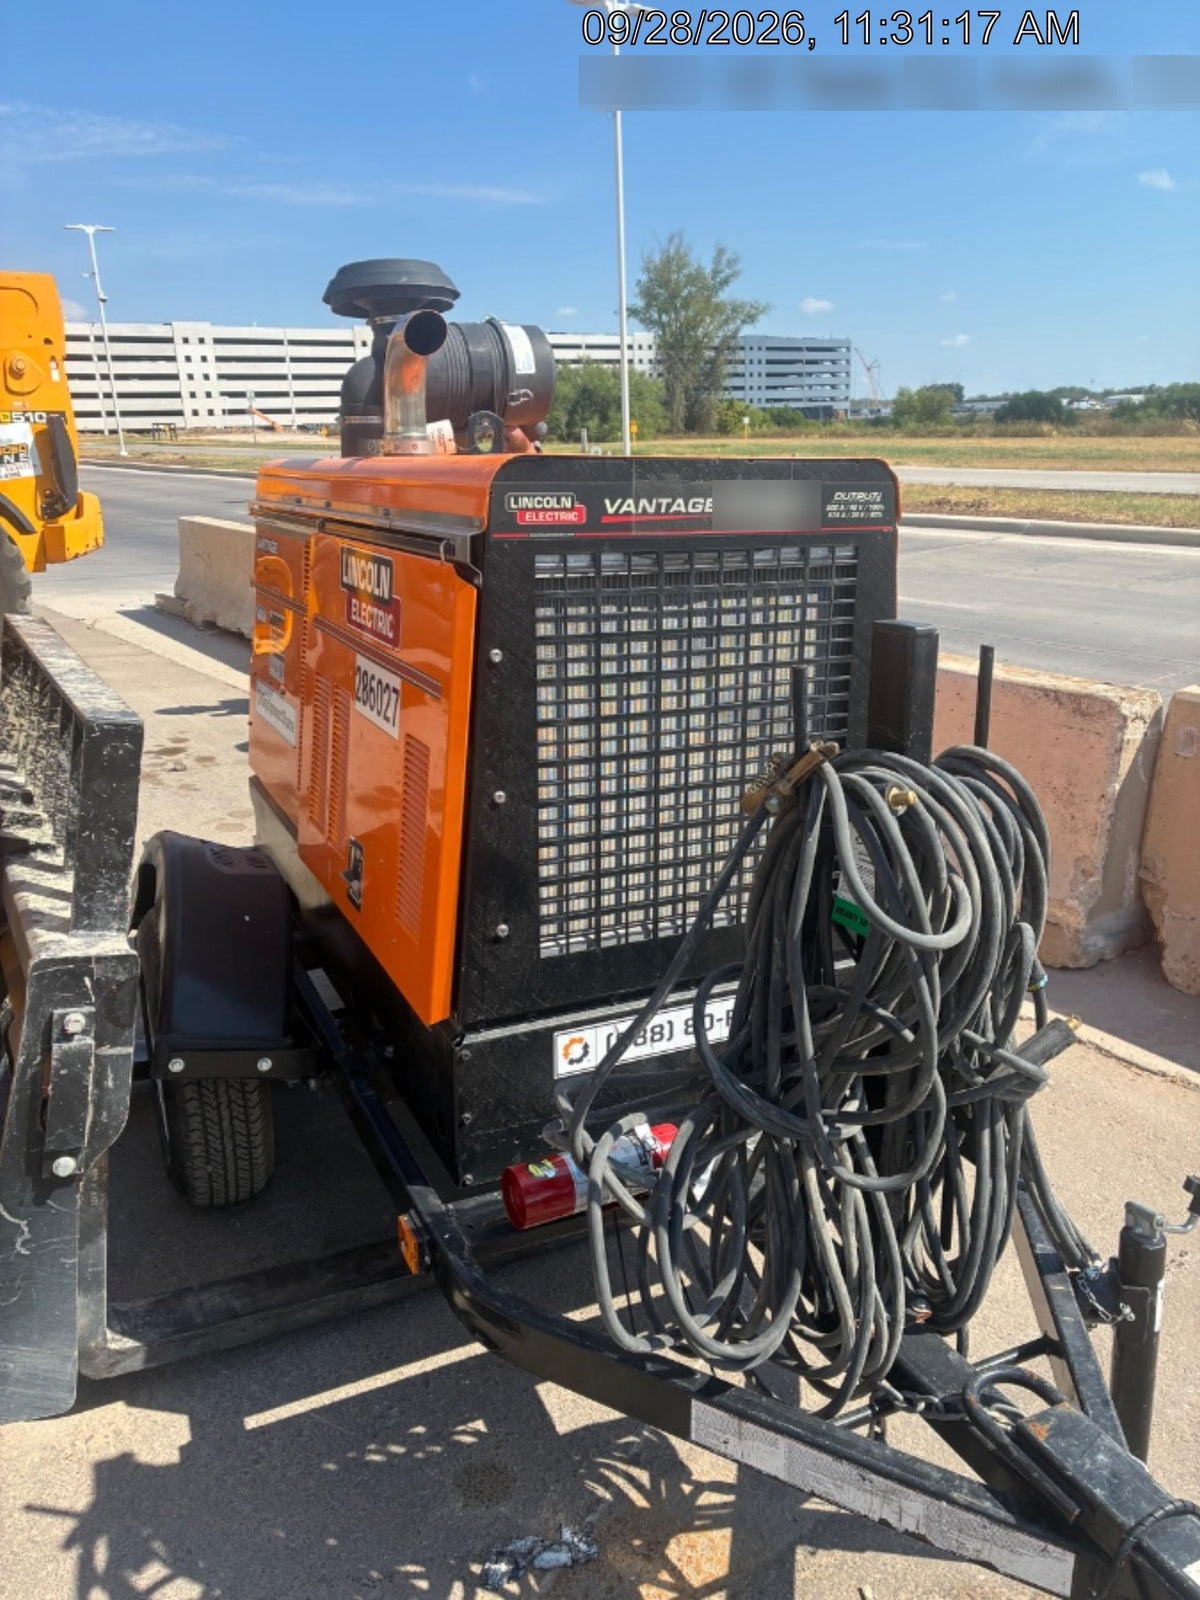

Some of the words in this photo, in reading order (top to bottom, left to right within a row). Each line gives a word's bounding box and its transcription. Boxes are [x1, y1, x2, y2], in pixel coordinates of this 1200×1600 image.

[510, 496, 572, 509] LINCOLN
[525, 511, 579, 522] ELECTRIC
[603, 498, 713, 515] VANTAGE
[342, 550, 391, 600] LINCOLN
[351, 598, 394, 639] ELECTRIC
[356, 664, 399, 728] 286027
[606, 1019, 674, 1053] (88)
